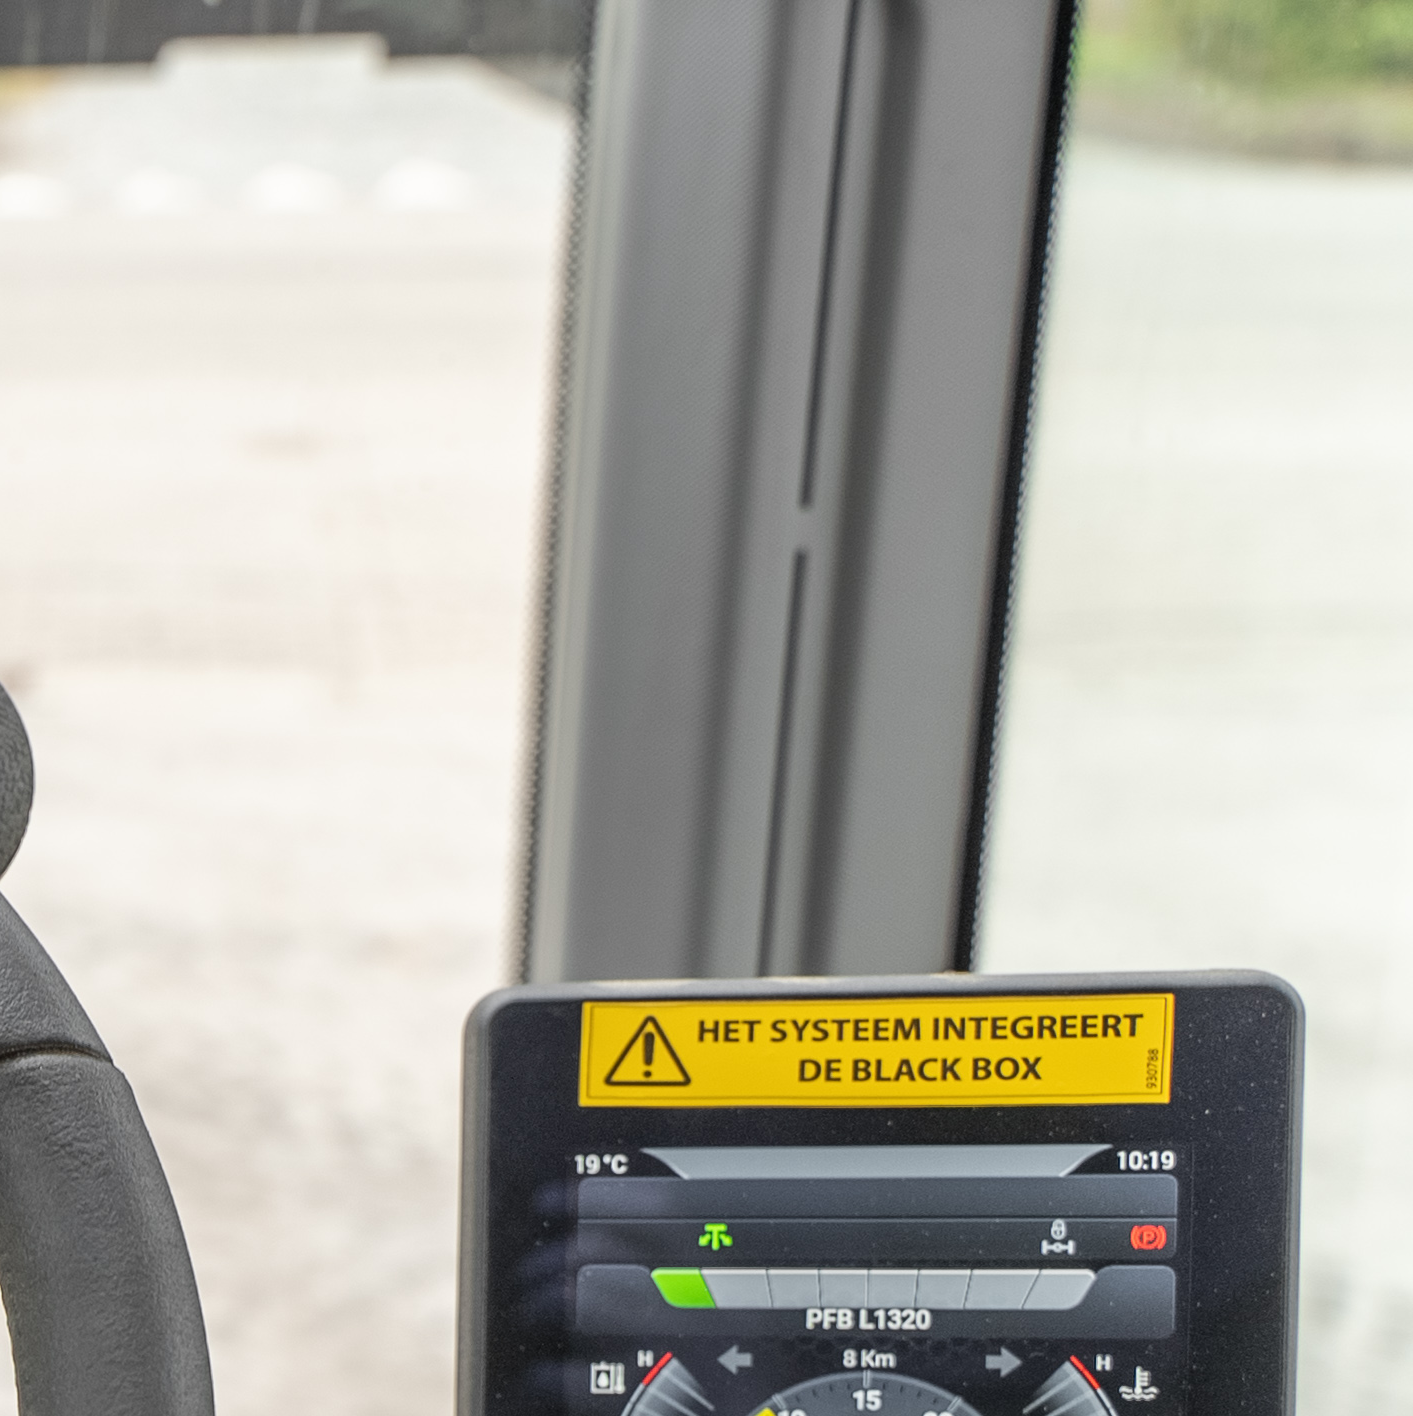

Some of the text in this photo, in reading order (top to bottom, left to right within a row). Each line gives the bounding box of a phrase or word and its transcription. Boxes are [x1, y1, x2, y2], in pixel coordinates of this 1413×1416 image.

[698, 1013, 1144, 1043] HET SYSTEEM INTEGREERT
[798, 1056, 1043, 1083] DE BLACK BOX
[1146, 1048, 1159, 1090] 930788
[1116, 1149, 1175, 1171] 10:19
[805, 1308, 931, 1331] PFB L1320
[637, 1350, 654, 1367] H
[843, 1350, 896, 1369] 8 Km
[1095, 1355, 1112, 1372] H
[852, 1390, 882, 1412] 15
